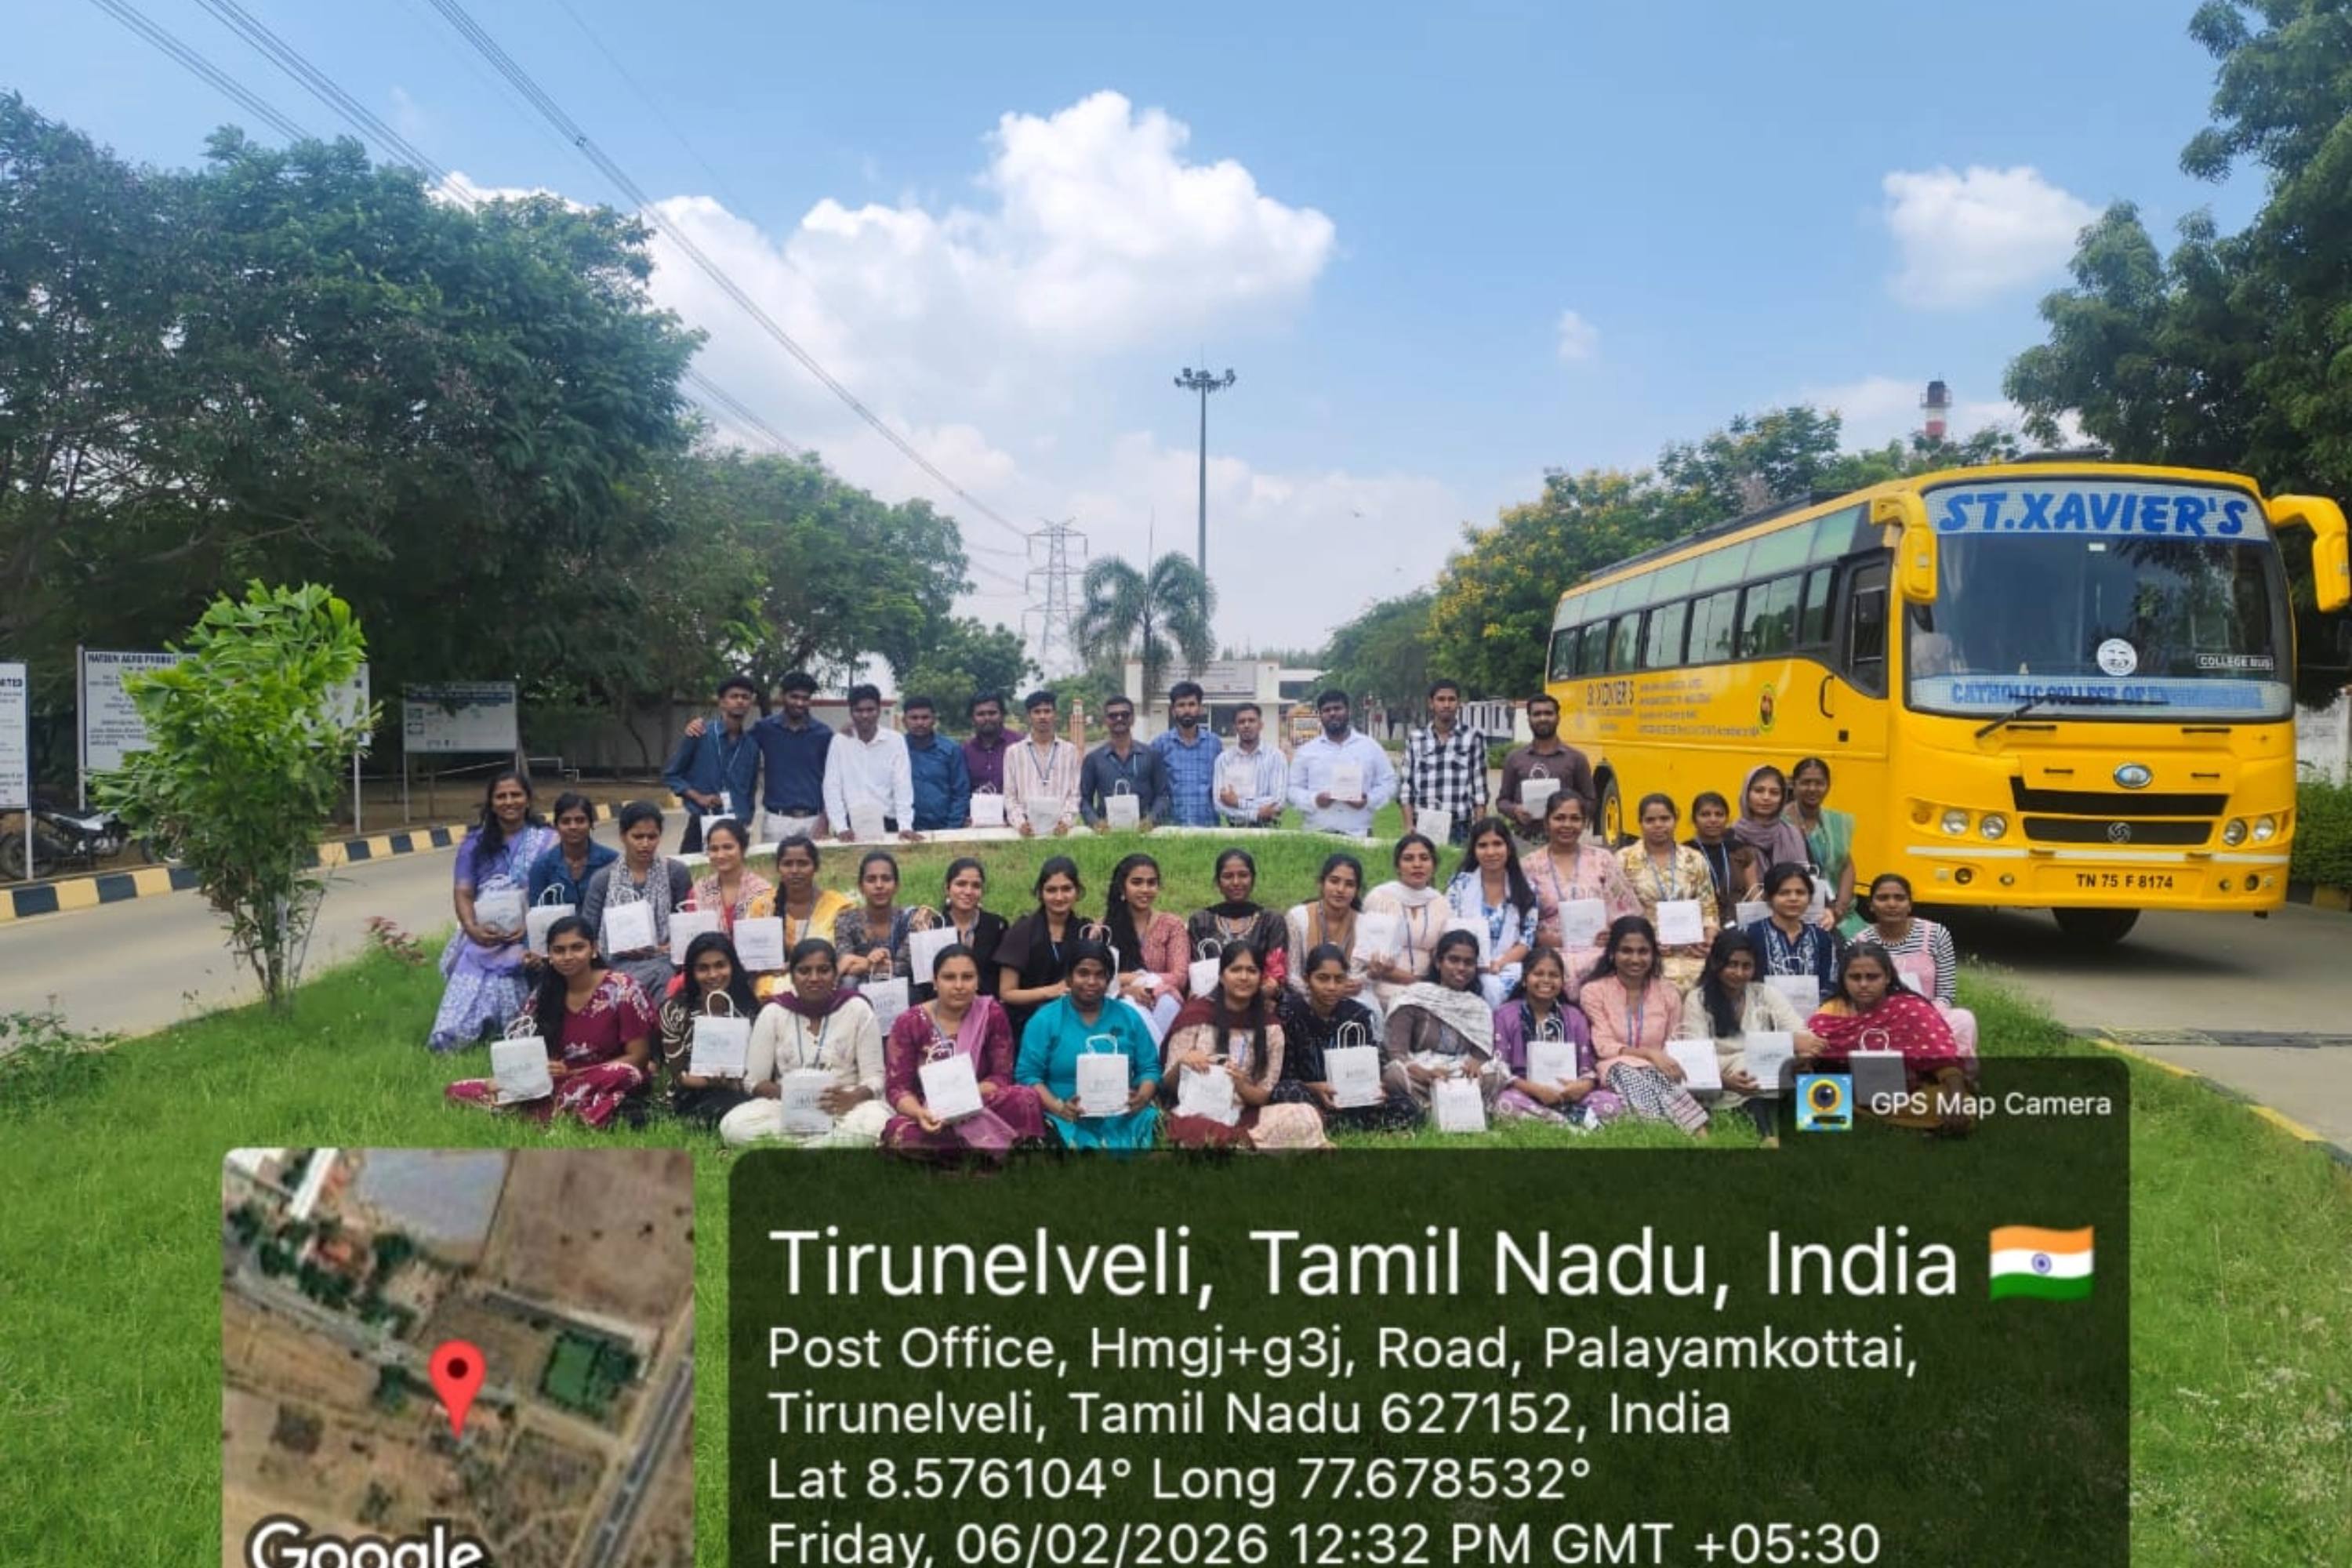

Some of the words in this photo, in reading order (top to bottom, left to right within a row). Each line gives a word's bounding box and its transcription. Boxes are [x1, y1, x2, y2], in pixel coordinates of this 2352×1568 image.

[2200, 656, 2249, 668] COLLEGE
[2076, 873, 2096, 887] TN
[2102, 873, 2118, 887] 75
[2125, 874, 2135, 887] F
[2138, 875, 2173, 888] 8174
